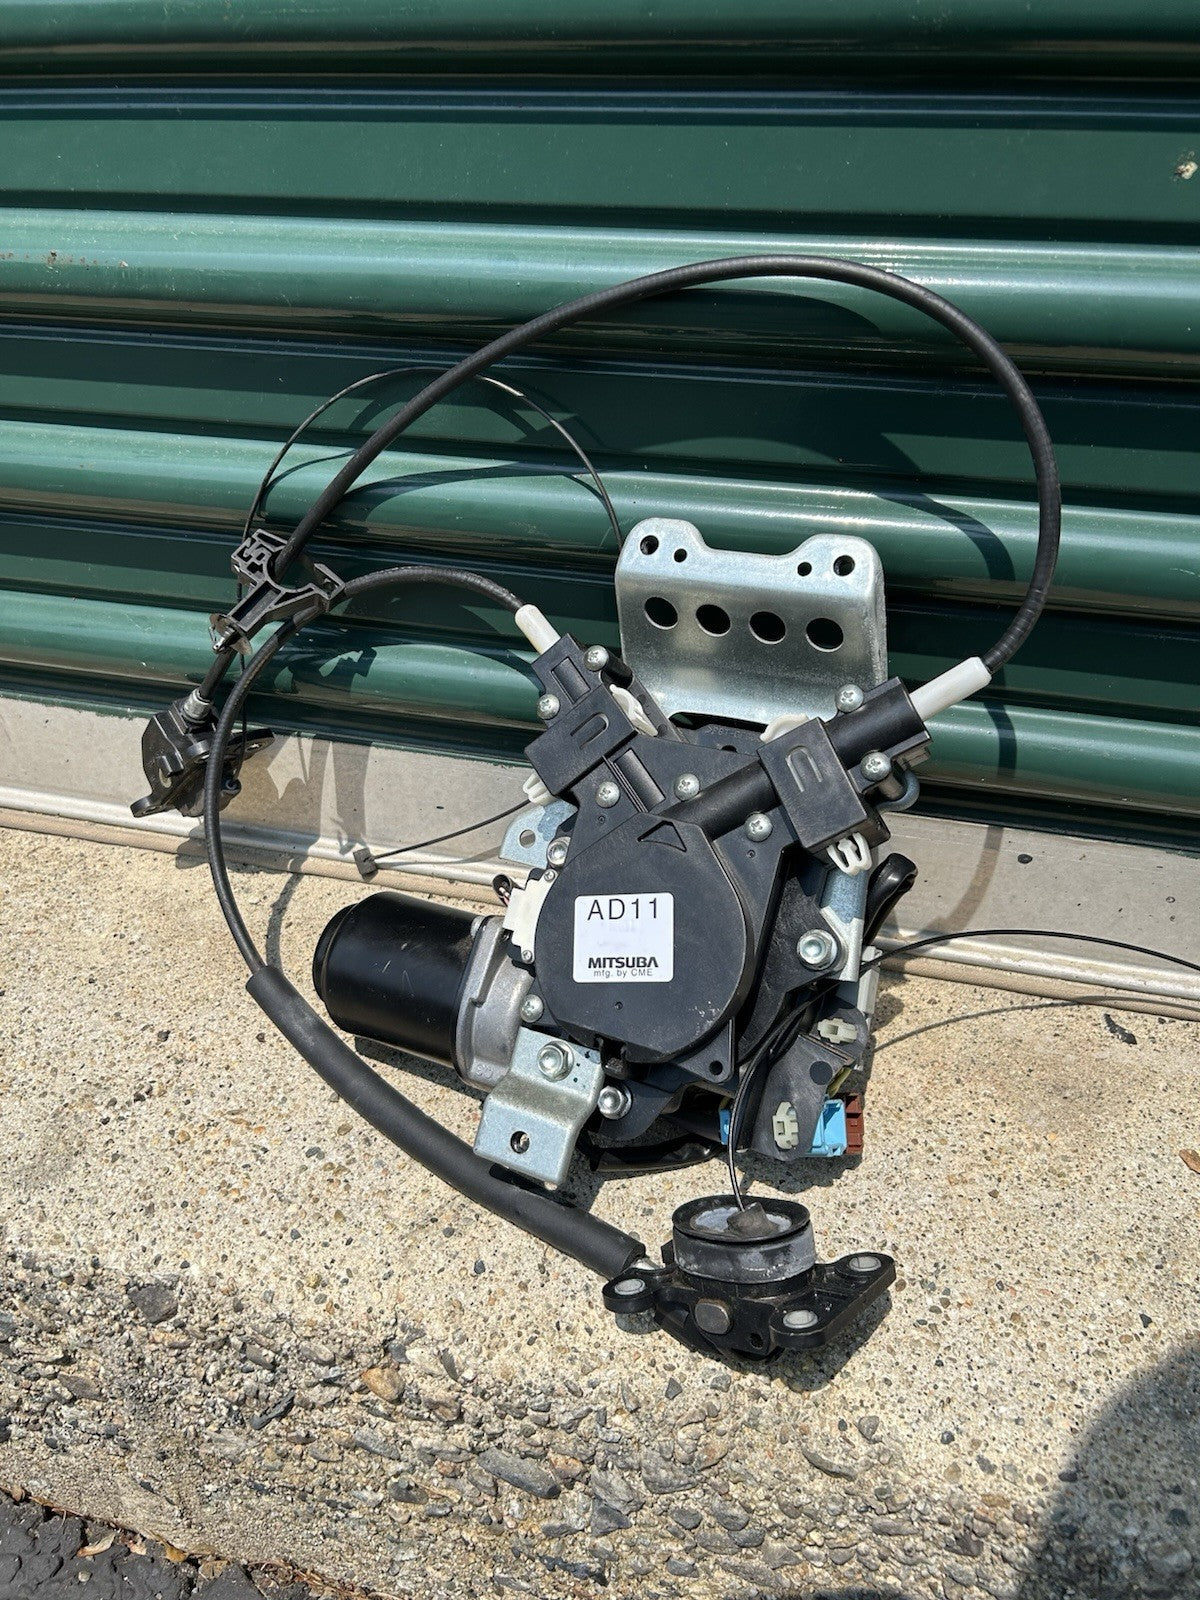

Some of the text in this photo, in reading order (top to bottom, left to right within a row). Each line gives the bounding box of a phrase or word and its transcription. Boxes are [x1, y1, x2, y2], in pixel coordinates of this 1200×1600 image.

[587, 897, 658, 921] AD11
[587, 956, 659, 969] MITSUBA
[593, 968, 653, 979] mfg. by CME
